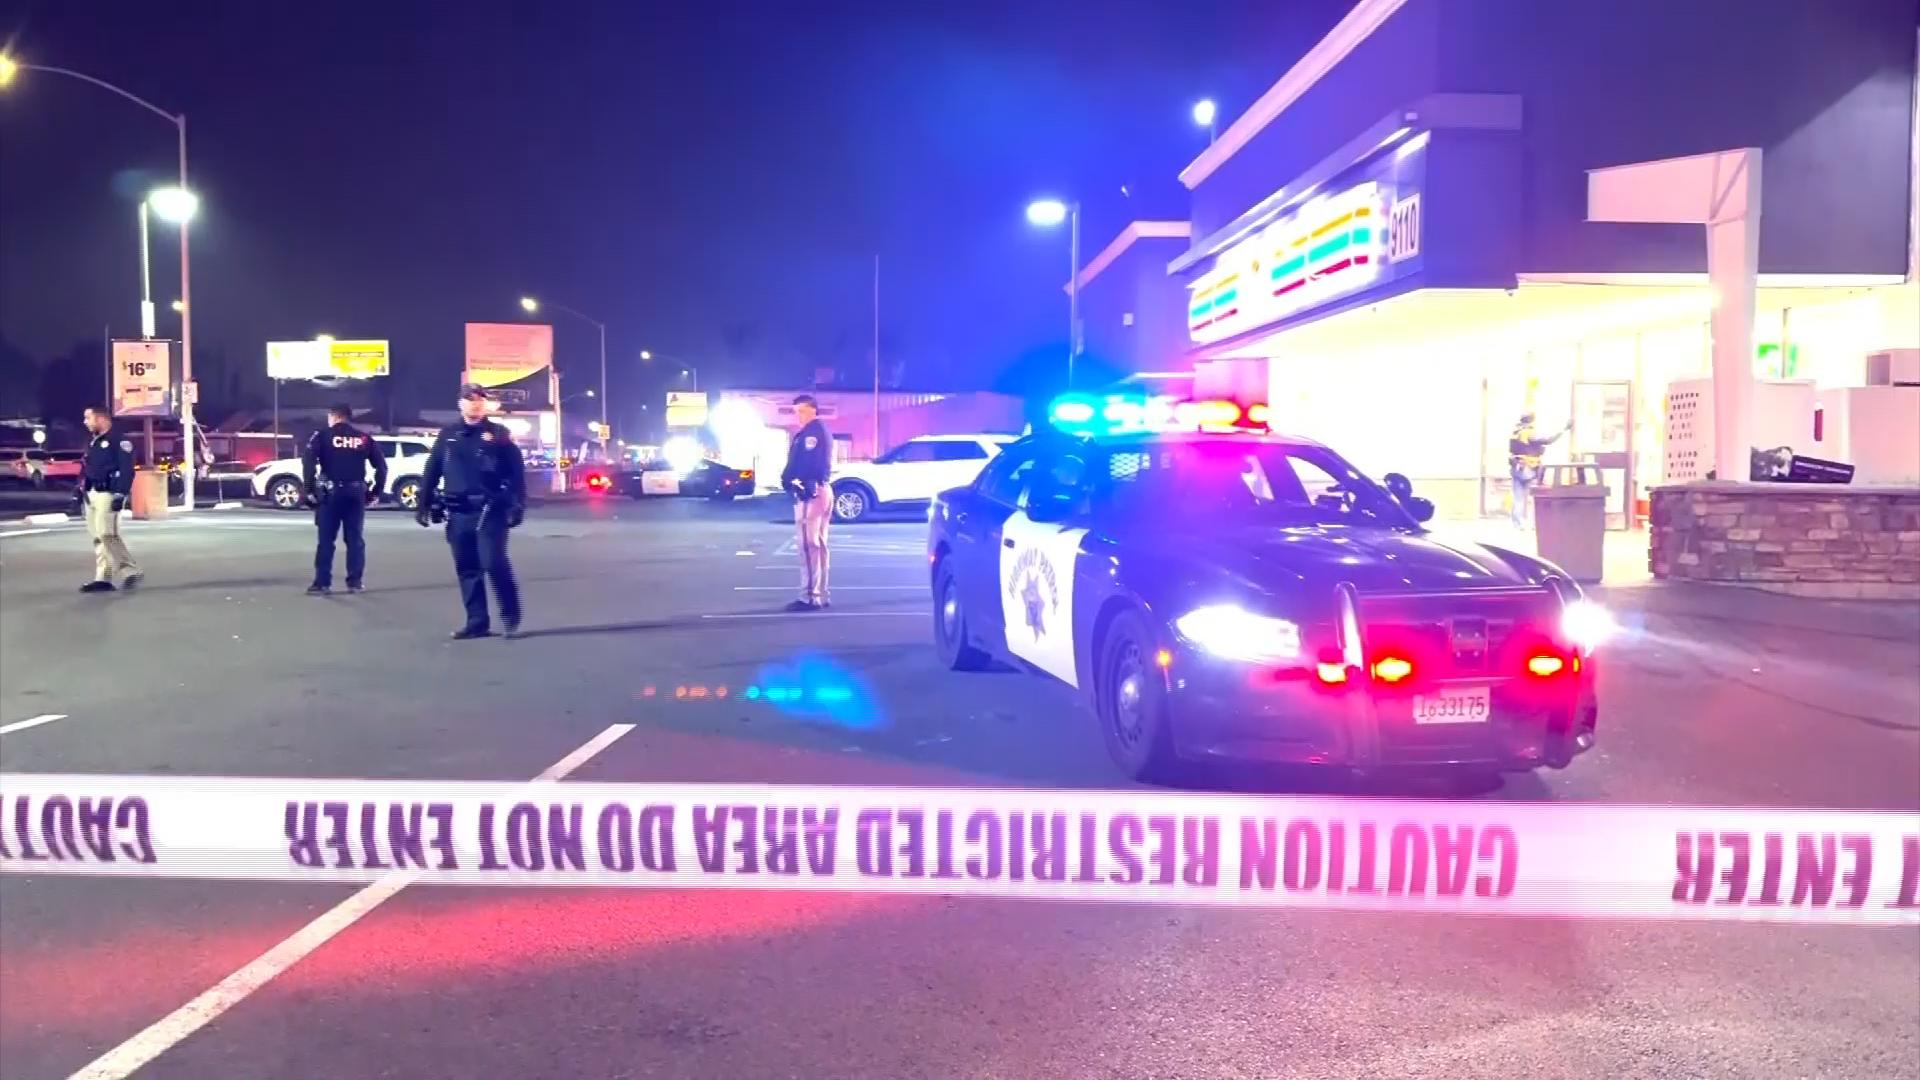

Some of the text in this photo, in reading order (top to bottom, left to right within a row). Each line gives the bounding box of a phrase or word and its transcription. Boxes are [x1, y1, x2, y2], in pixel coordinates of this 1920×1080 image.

[1391, 202, 1417, 257] 9110
[332, 436, 364, 449] CHP
[285, 802, 1519, 897] CAUTION RESTRICTED AREA DO NOT ENTER
[1672, 832, 1873, 909] ENTER
